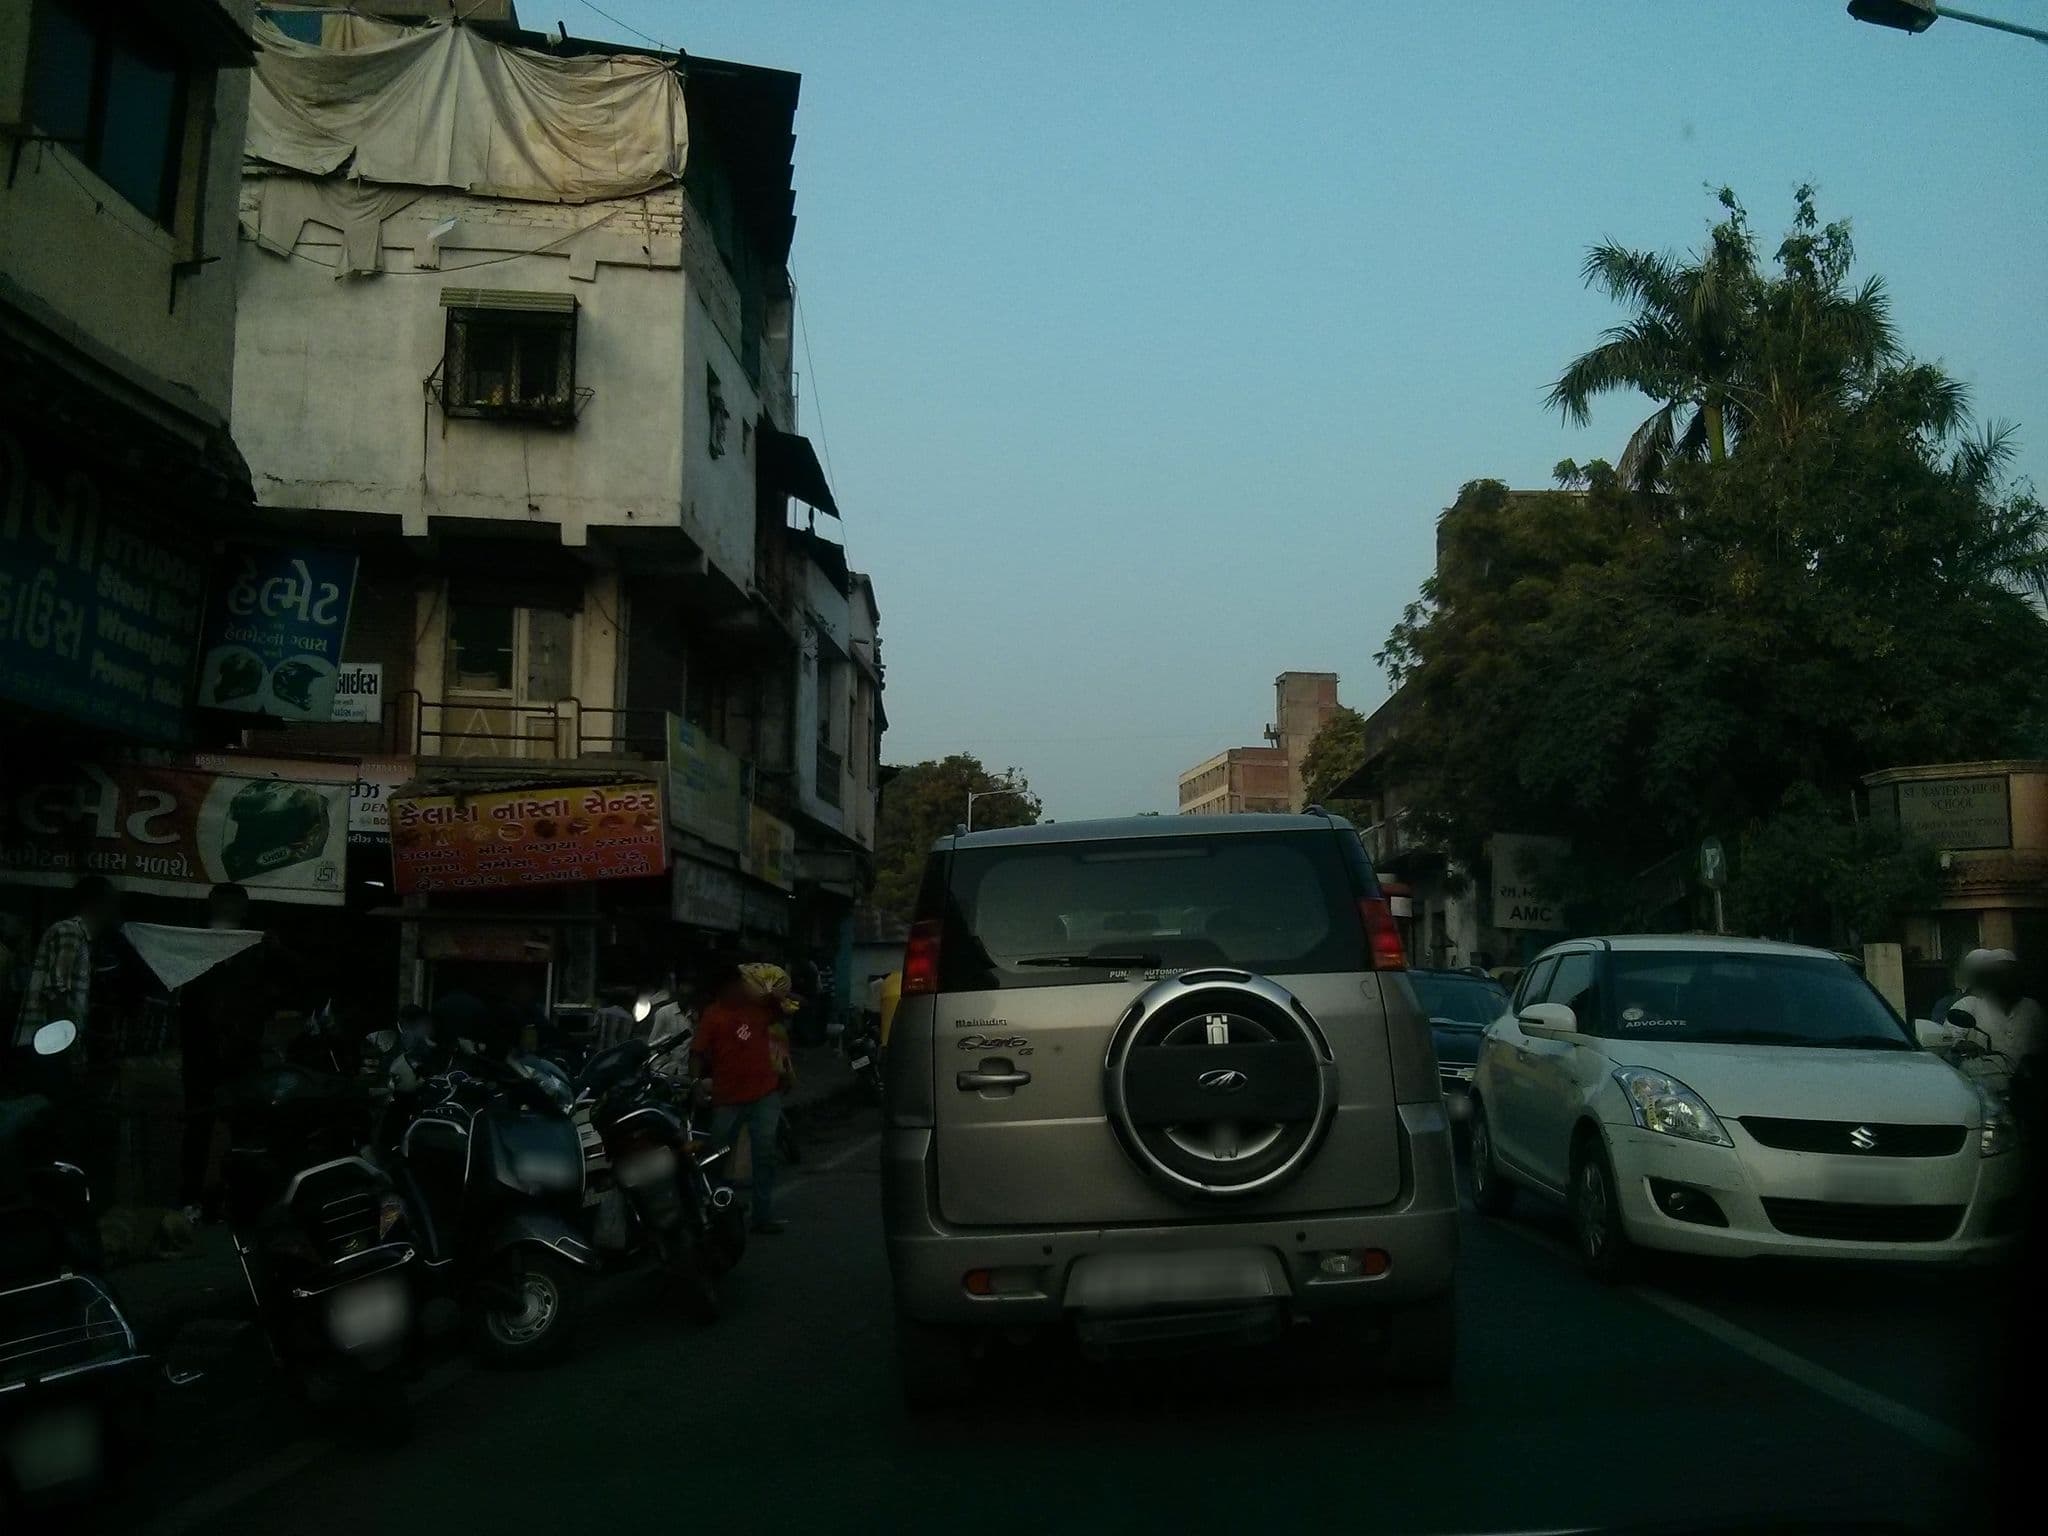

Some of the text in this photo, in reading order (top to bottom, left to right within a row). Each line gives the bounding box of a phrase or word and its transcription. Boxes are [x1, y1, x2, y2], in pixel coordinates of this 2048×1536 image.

[493, 800, 569, 820] નાસ્તા
[585, 790, 656, 814] સેન્ટર
[1510, 904, 1553, 922] AMC
[1624, 1019, 1688, 1029] ADVOCATE
